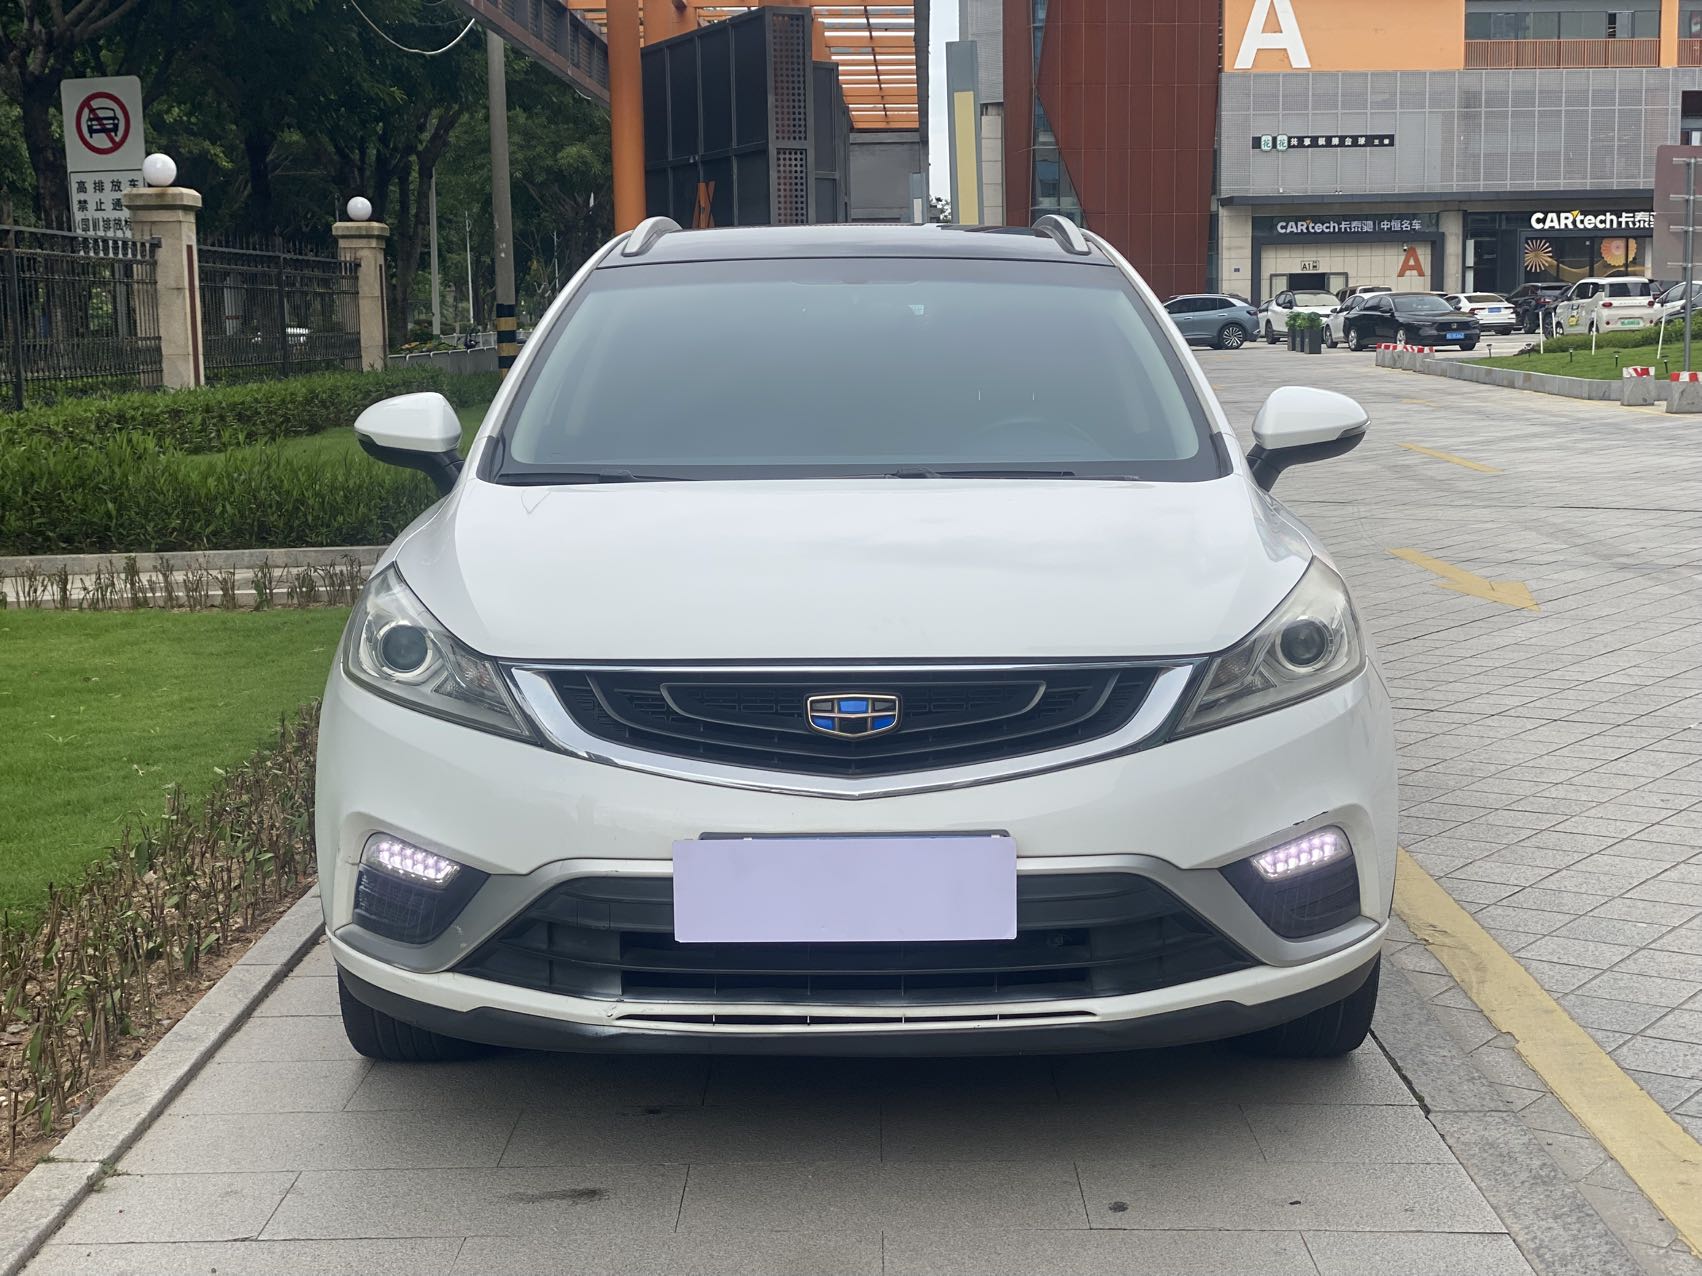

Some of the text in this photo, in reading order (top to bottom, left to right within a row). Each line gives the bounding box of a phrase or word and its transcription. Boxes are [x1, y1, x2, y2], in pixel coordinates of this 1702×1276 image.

[1234, 0, 1312, 69] A
[1381, 219, 1422, 231] 中恒名车
[1397, 246, 1425, 277] A
